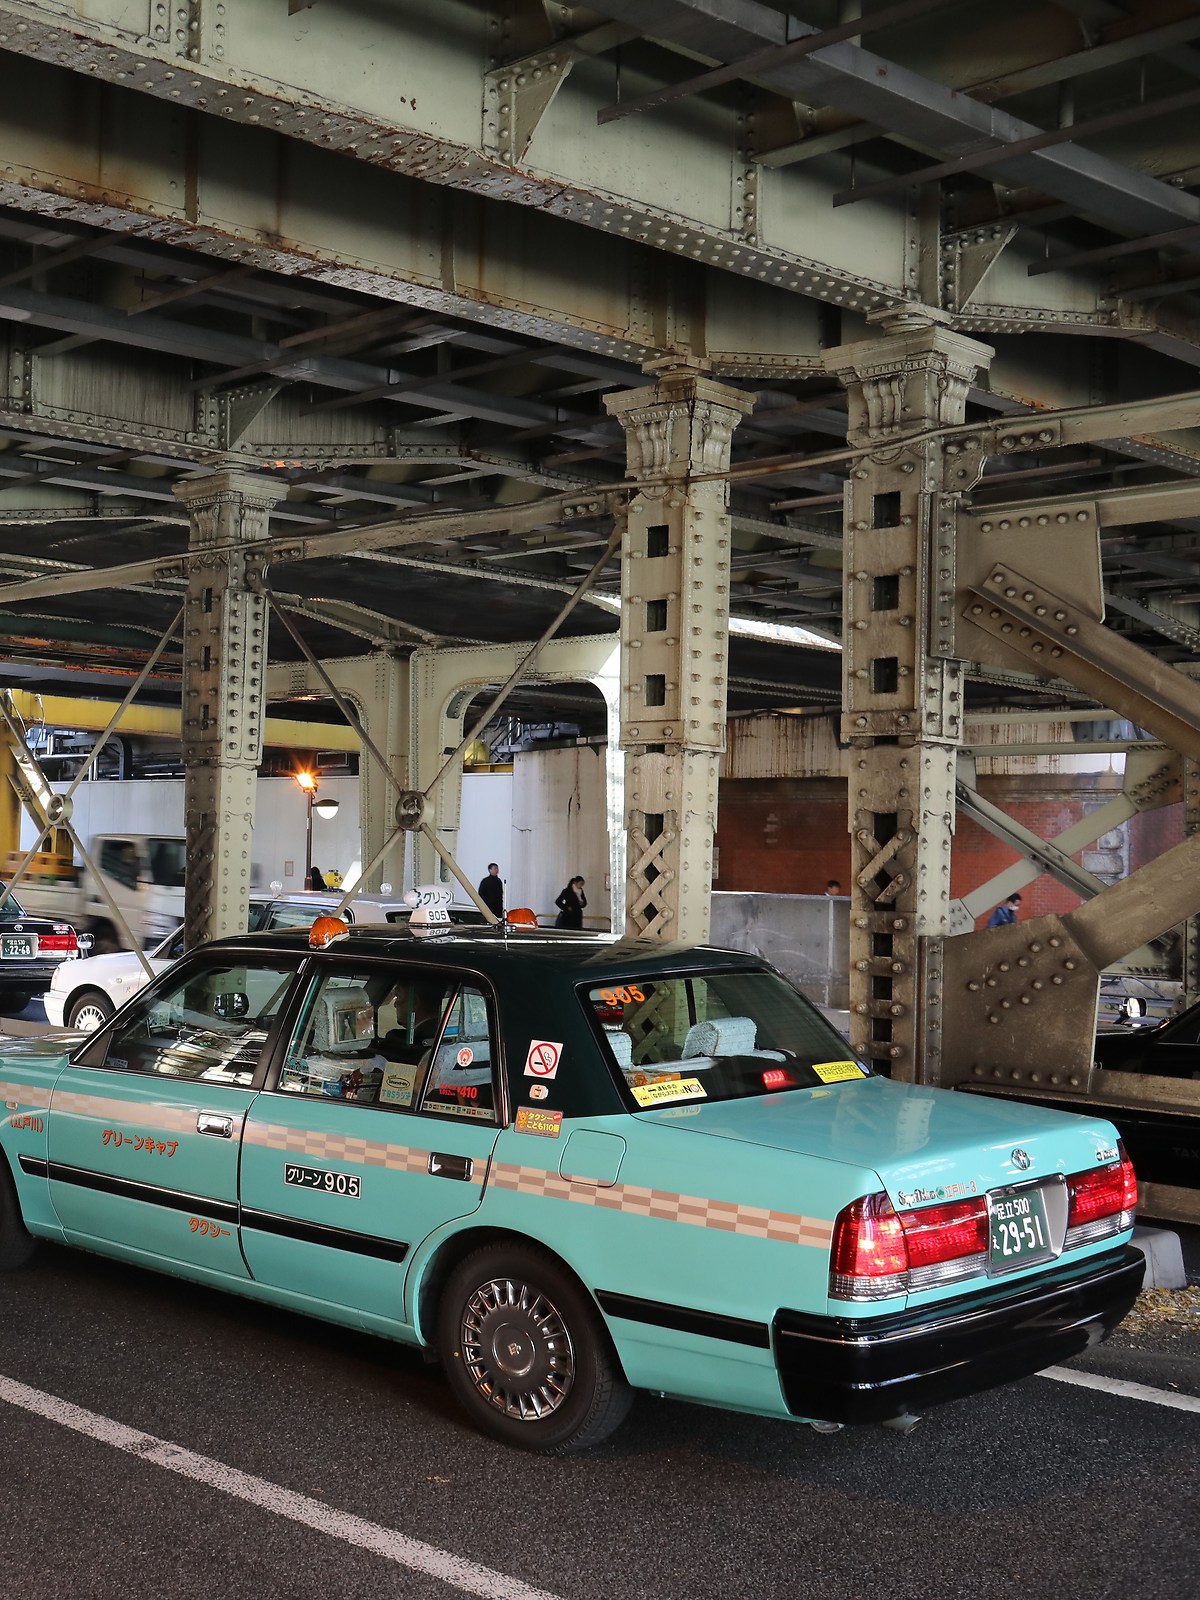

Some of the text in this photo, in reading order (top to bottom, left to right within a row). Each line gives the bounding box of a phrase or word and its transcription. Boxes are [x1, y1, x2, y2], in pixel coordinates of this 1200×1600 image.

[423, 891, 452, 905] グリーン
[428, 910, 447, 921] 905
[9, 945, 31, 955] 22-68
[599, 984, 646, 1006] 905
[528, 1112, 554, 1121] タクシー
[102, 1129, 179, 1157] グリーンキャブ
[287, 1168, 359, 1196] グリーン 905
[189, 1217, 230, 1238] タクシー
[998, 1215, 1044, 1256] 29-51
